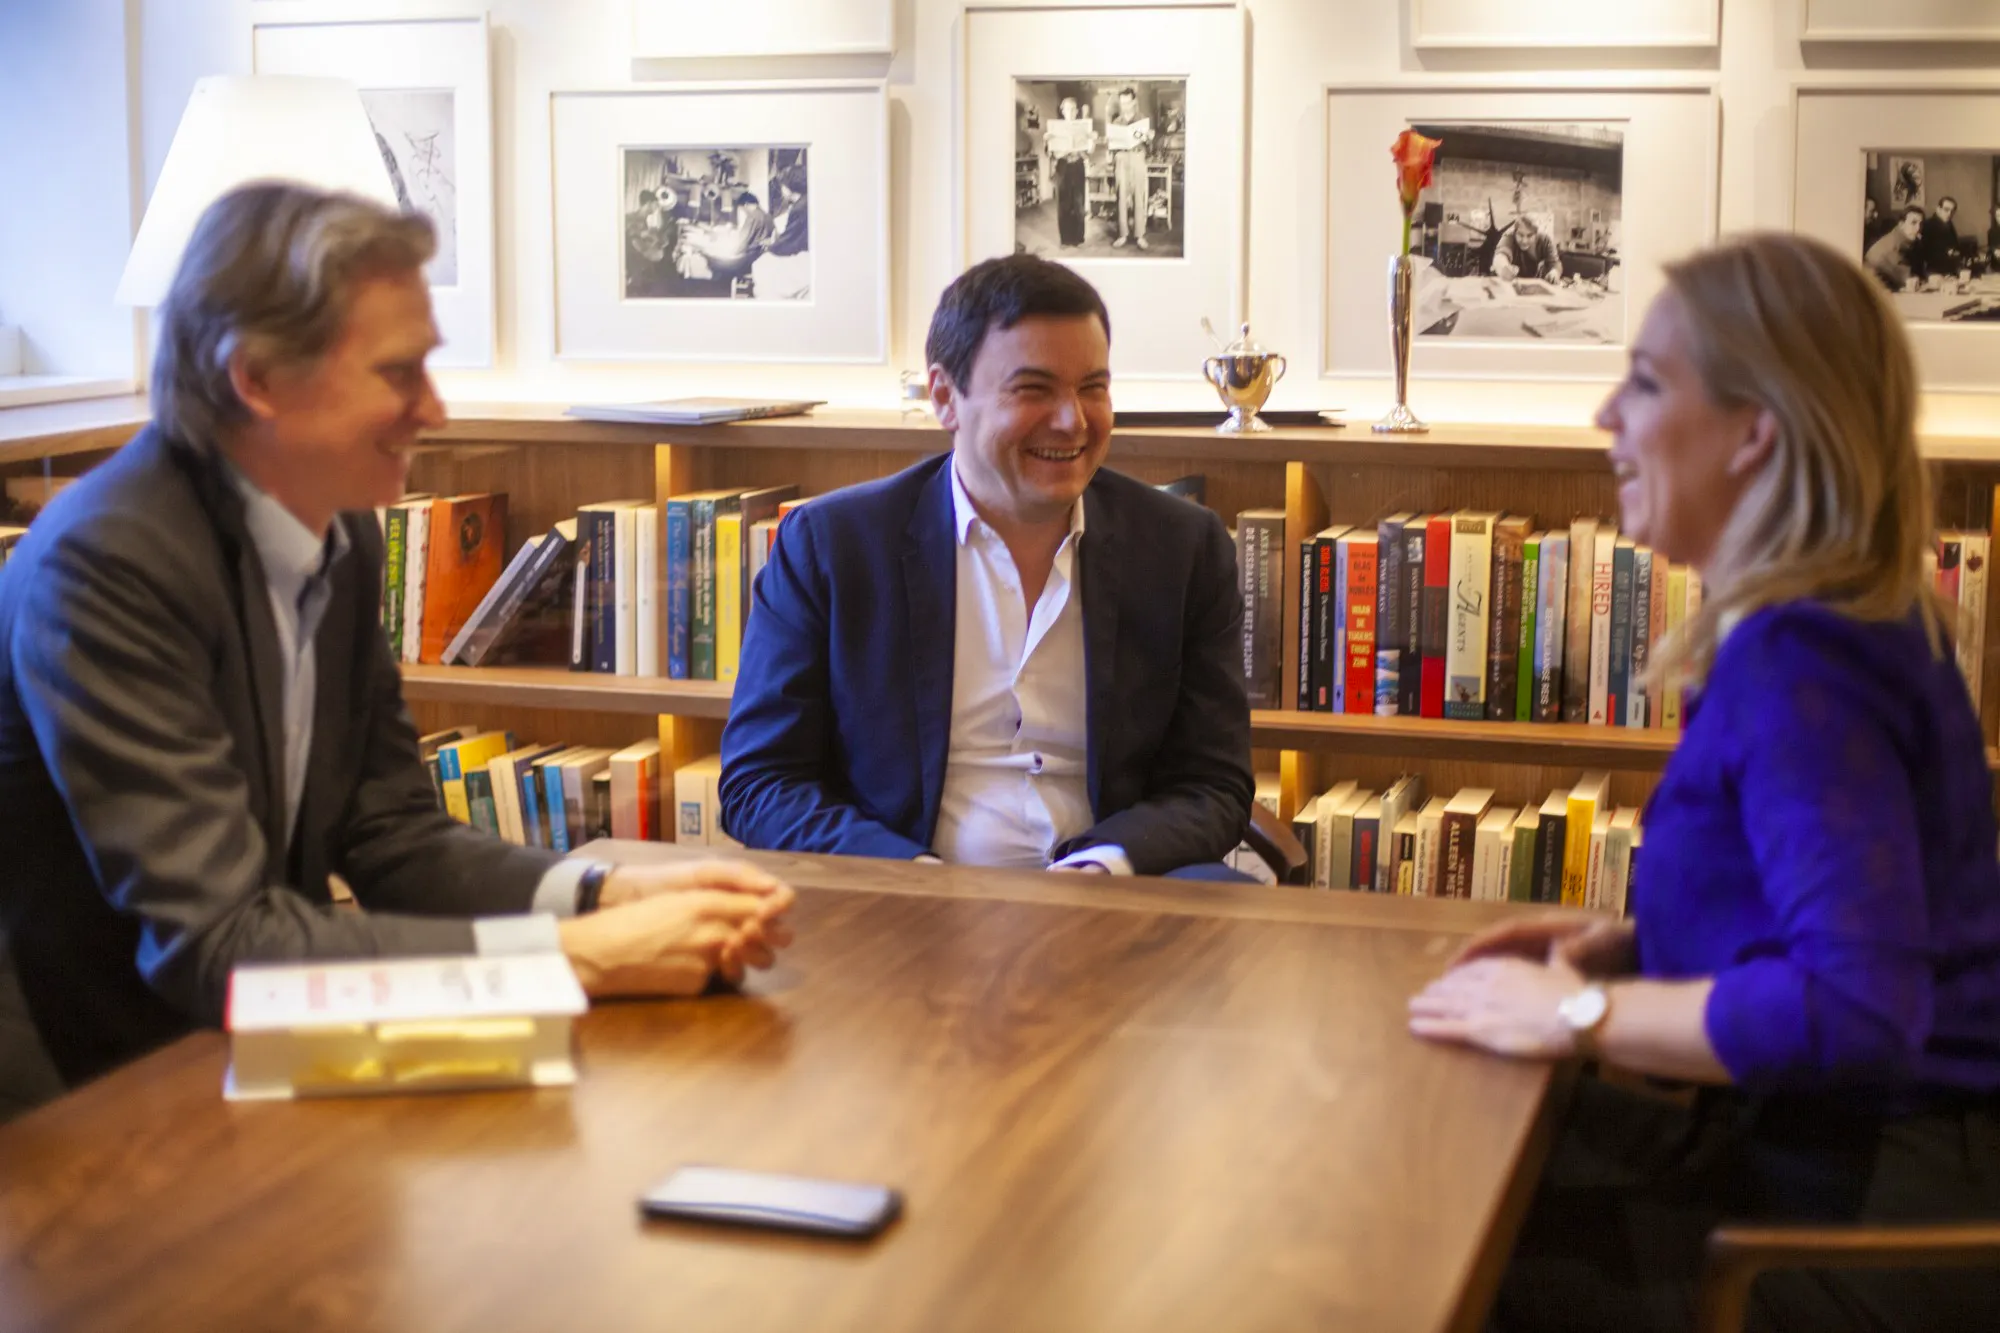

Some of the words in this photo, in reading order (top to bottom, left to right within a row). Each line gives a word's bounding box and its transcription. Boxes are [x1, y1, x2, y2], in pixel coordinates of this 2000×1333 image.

[1245, 527, 1255, 540] DE
[1260, 527, 1269, 557] ANNA
[1244, 543, 1255, 592] MISDAAD
[1244, 594, 1253, 608] EN
[1594, 562, 1613, 616] HIRED
[1243, 610, 1253, 630] HET
[1356, 618, 1365, 628] DE
[1455, 580, 1481, 653] AGENTS
[1636, 590, 1648, 640] BLOOM
[1446, 821, 1460, 872] ALLEEN
